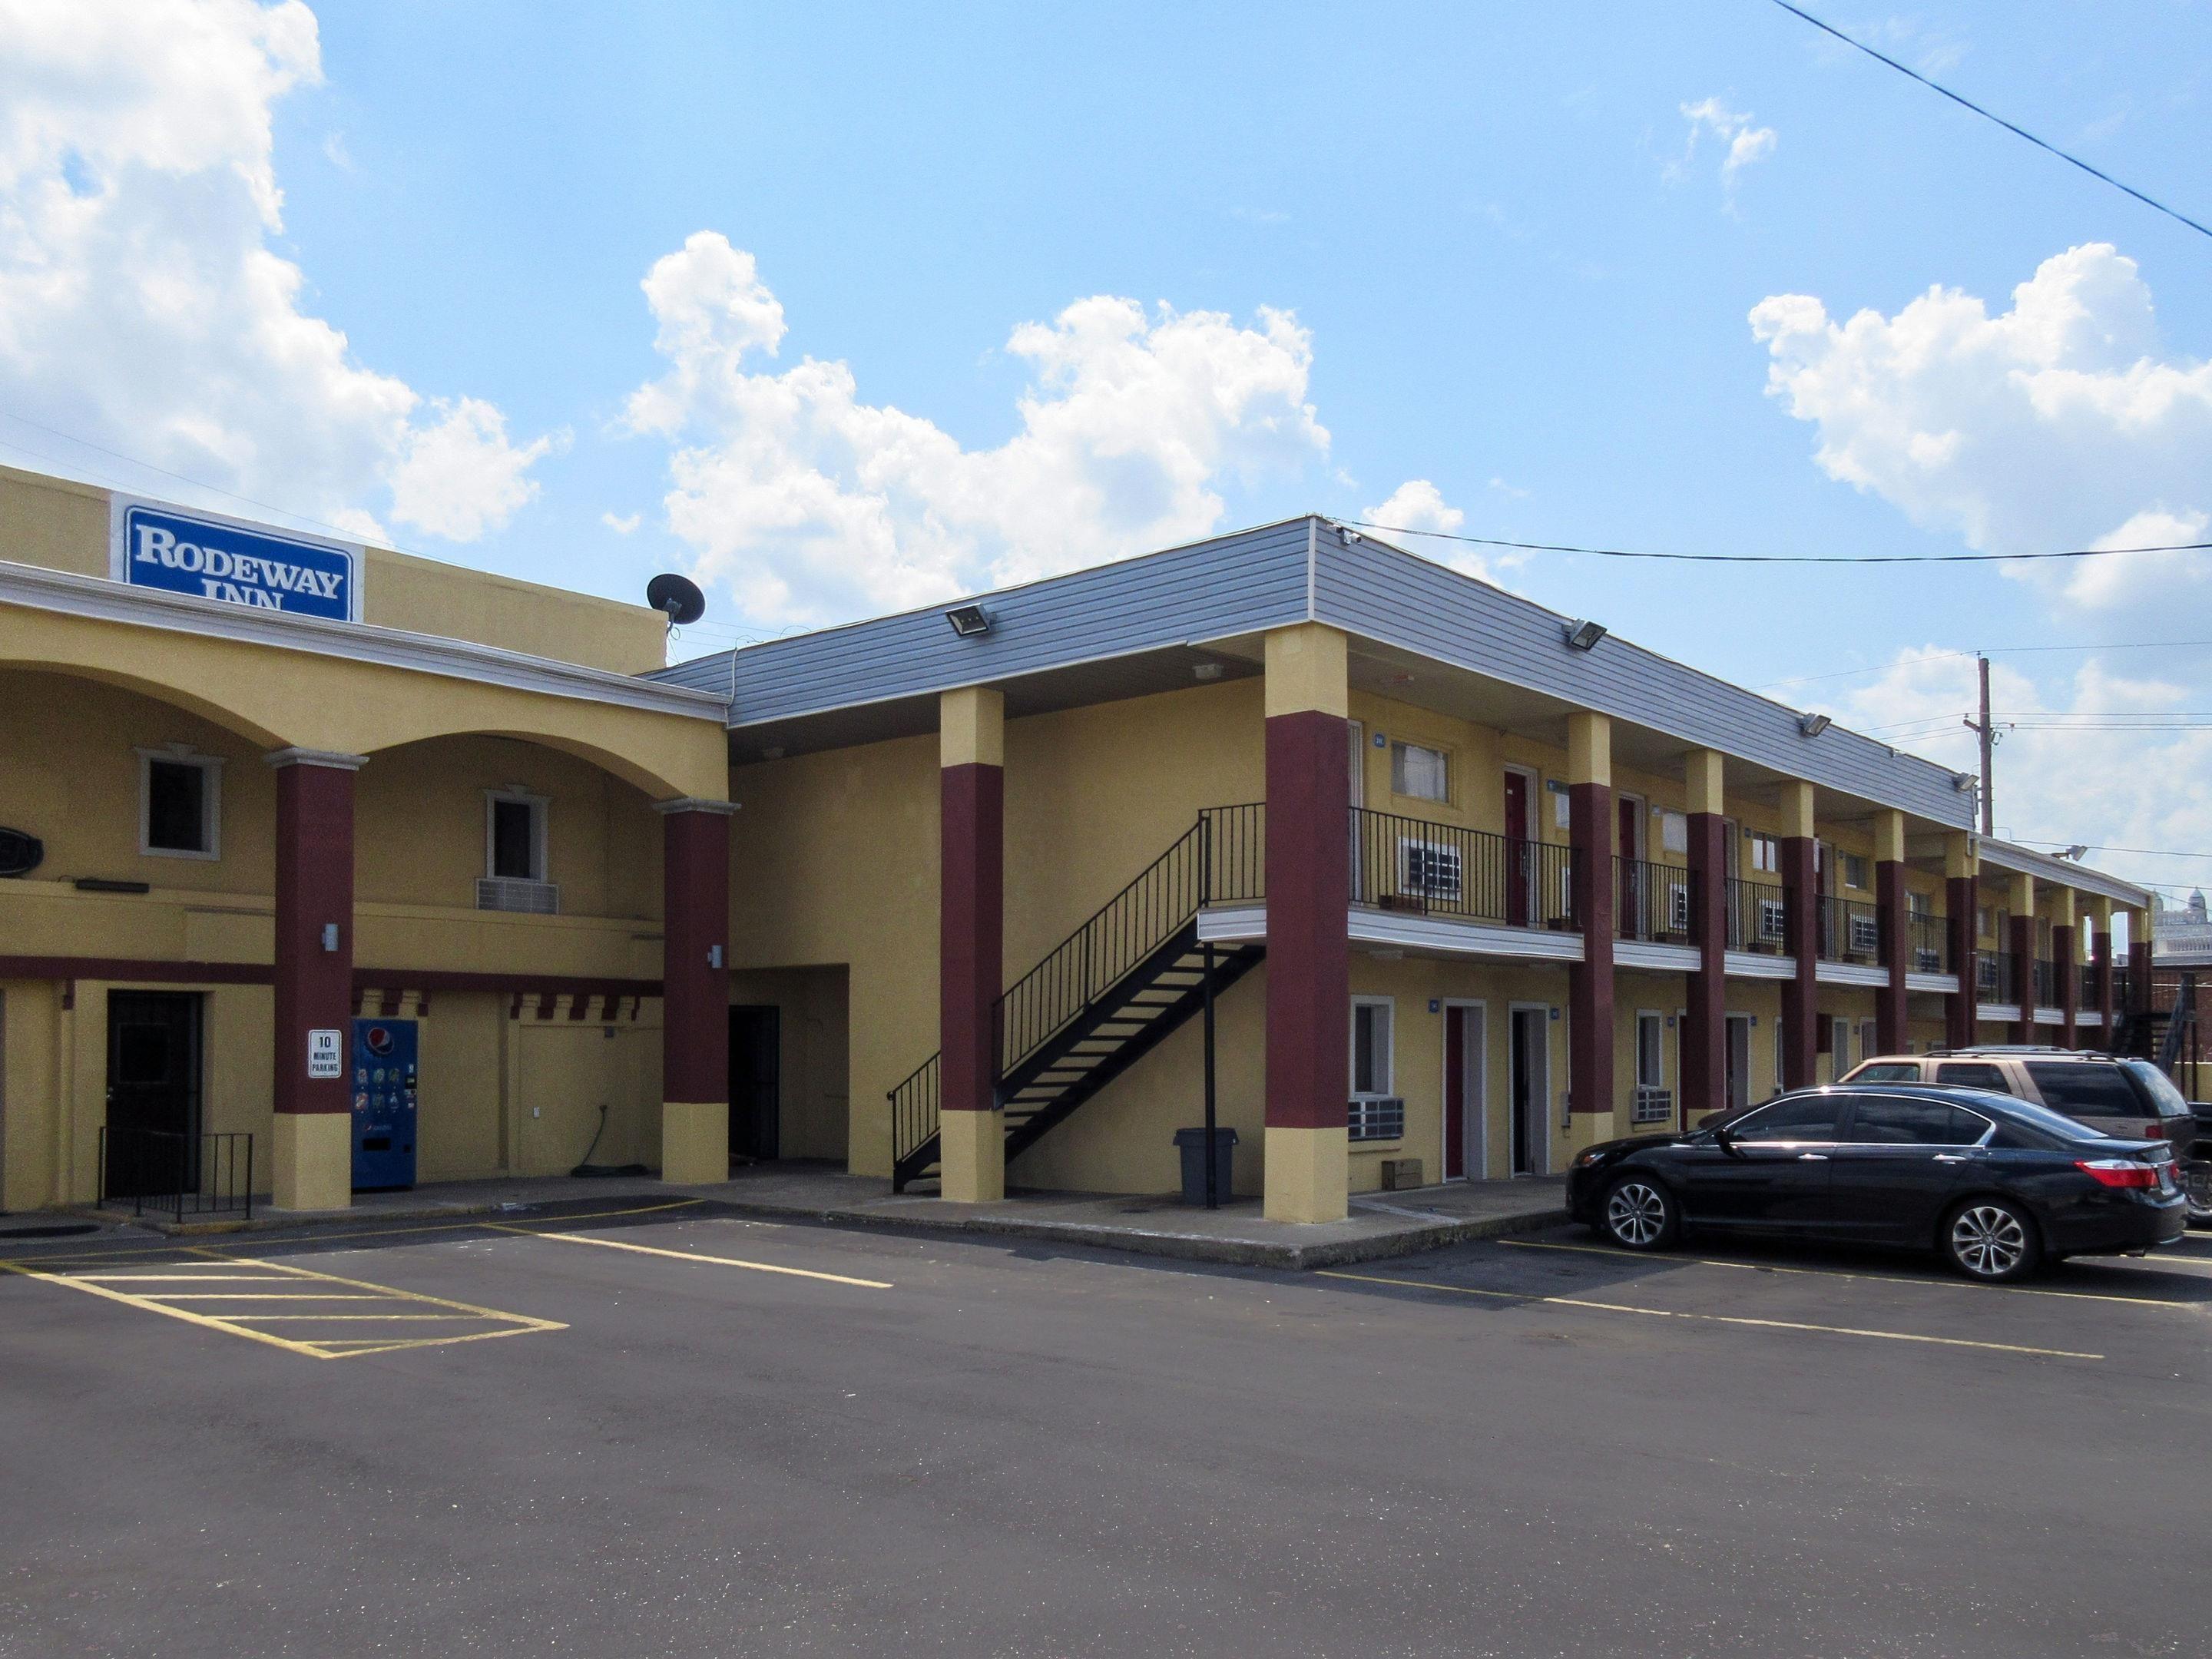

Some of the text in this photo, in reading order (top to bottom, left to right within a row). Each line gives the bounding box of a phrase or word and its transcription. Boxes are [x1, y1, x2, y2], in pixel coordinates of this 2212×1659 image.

[136, 525, 343, 600] RODEWAY
[201, 579, 284, 611] INN
[320, 1036, 331, 1048] 10
[313, 1052, 336, 1061] MINUTE
